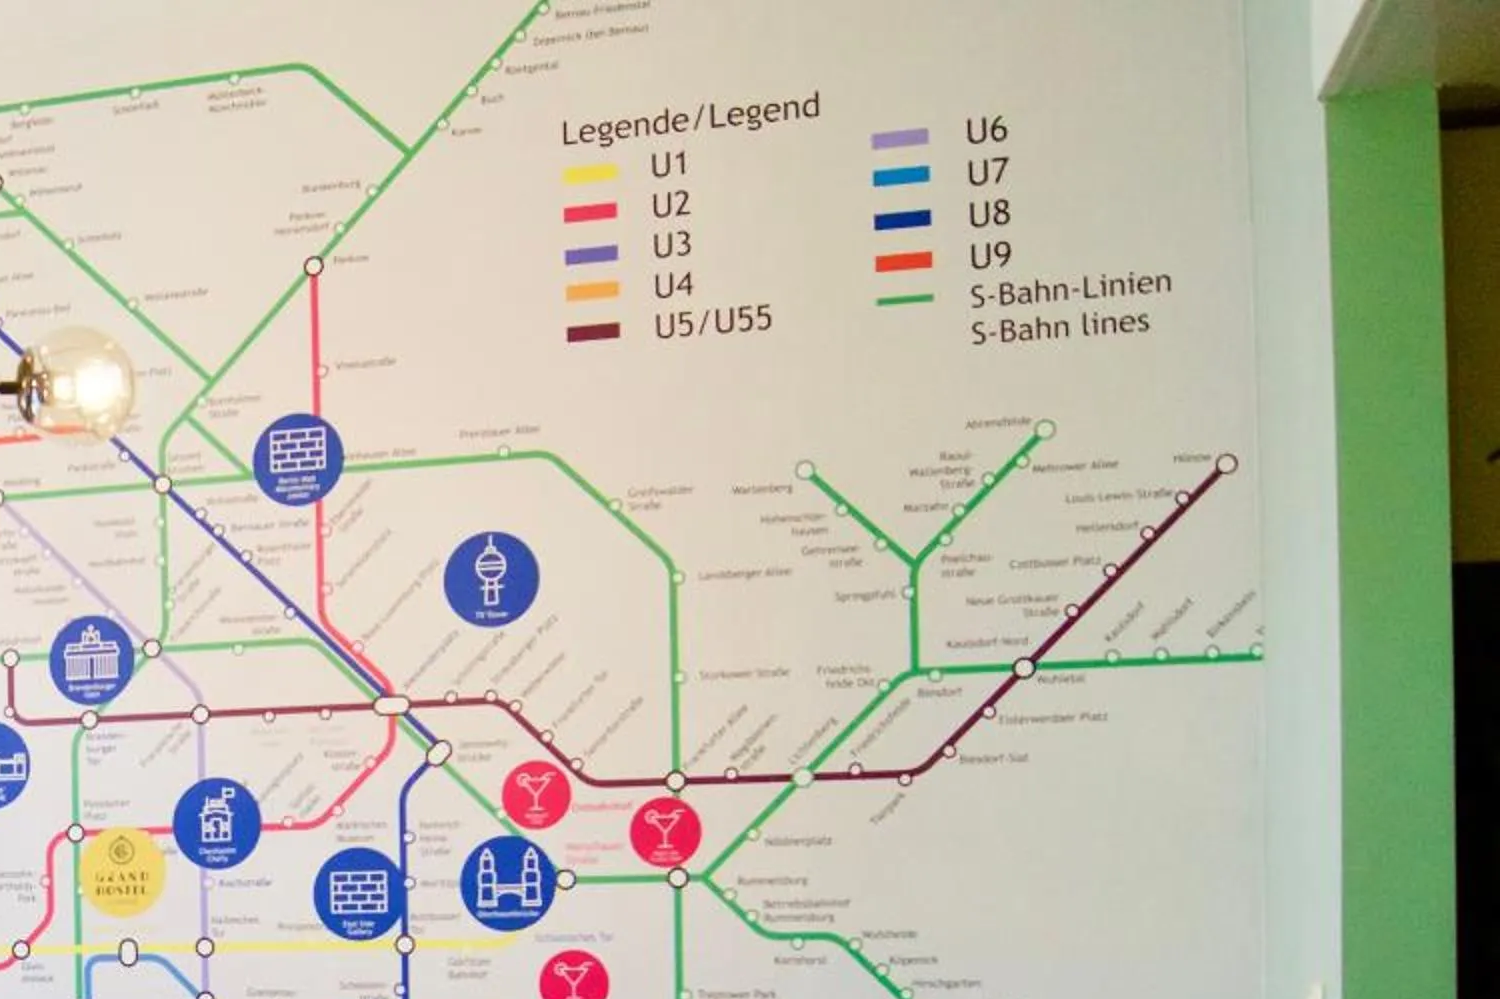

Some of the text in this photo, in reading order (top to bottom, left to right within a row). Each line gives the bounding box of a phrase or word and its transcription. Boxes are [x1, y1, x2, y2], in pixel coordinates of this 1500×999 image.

[562, 91, 819, 147] Legende/Legend
[966, 116, 1007, 144] U6
[651, 151, 685, 178] U1
[967, 157, 1009, 186] U7
[652, 190, 690, 218] U2
[969, 199, 1010, 228] U8
[653, 231, 691, 258] U3
[970, 241, 1011, 269] U9
[654, 272, 692, 298] U4
[970, 271, 1171, 309] S-Bahn-Linien
[655, 304, 772, 339] U5/U55
[971, 312, 1150, 345] S-Bahn lines
